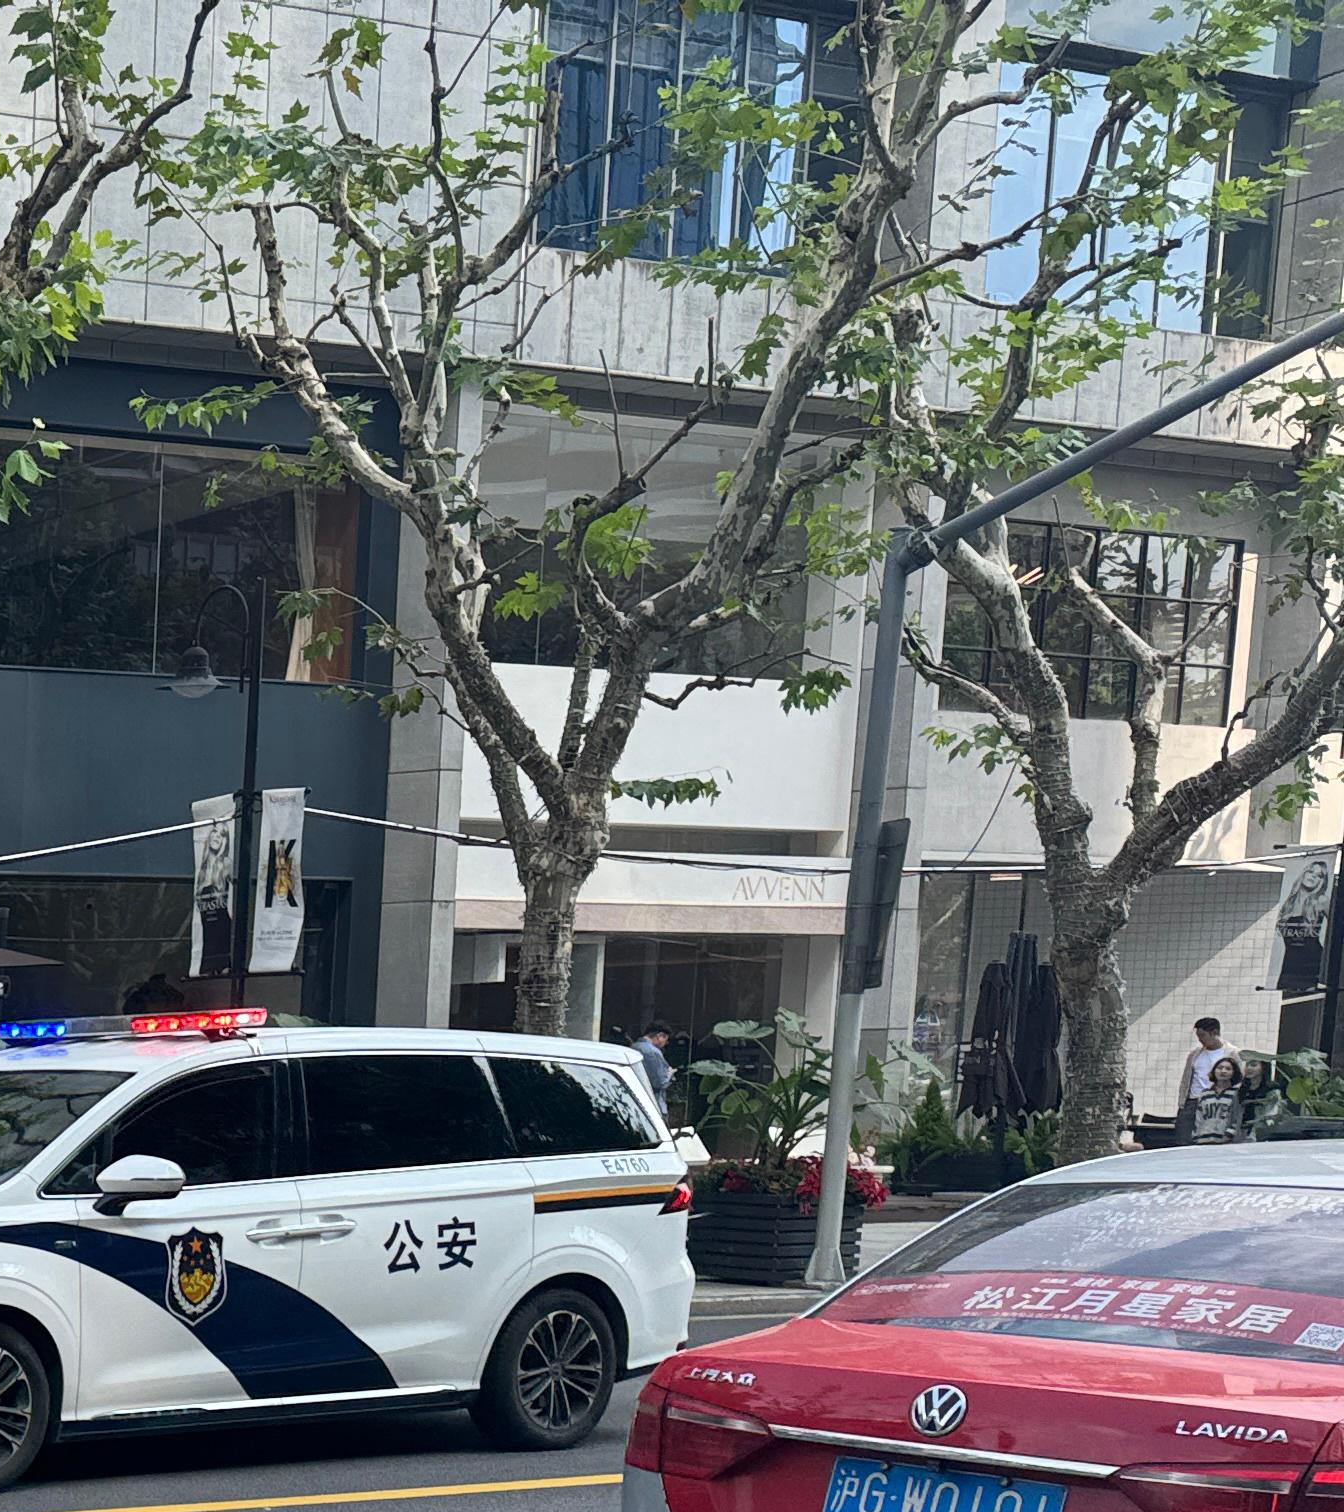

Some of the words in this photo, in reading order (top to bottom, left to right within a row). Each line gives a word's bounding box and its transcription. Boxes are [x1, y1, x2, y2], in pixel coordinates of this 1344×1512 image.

[732, 875, 826, 902] AVVENN
[601, 1157, 650, 1175] E4760
[383, 1215, 478, 1274] 公安
[963, 1286, 1293, 1334] 松江月星家居
[1175, 1419, 1290, 1444] LAVIDA
